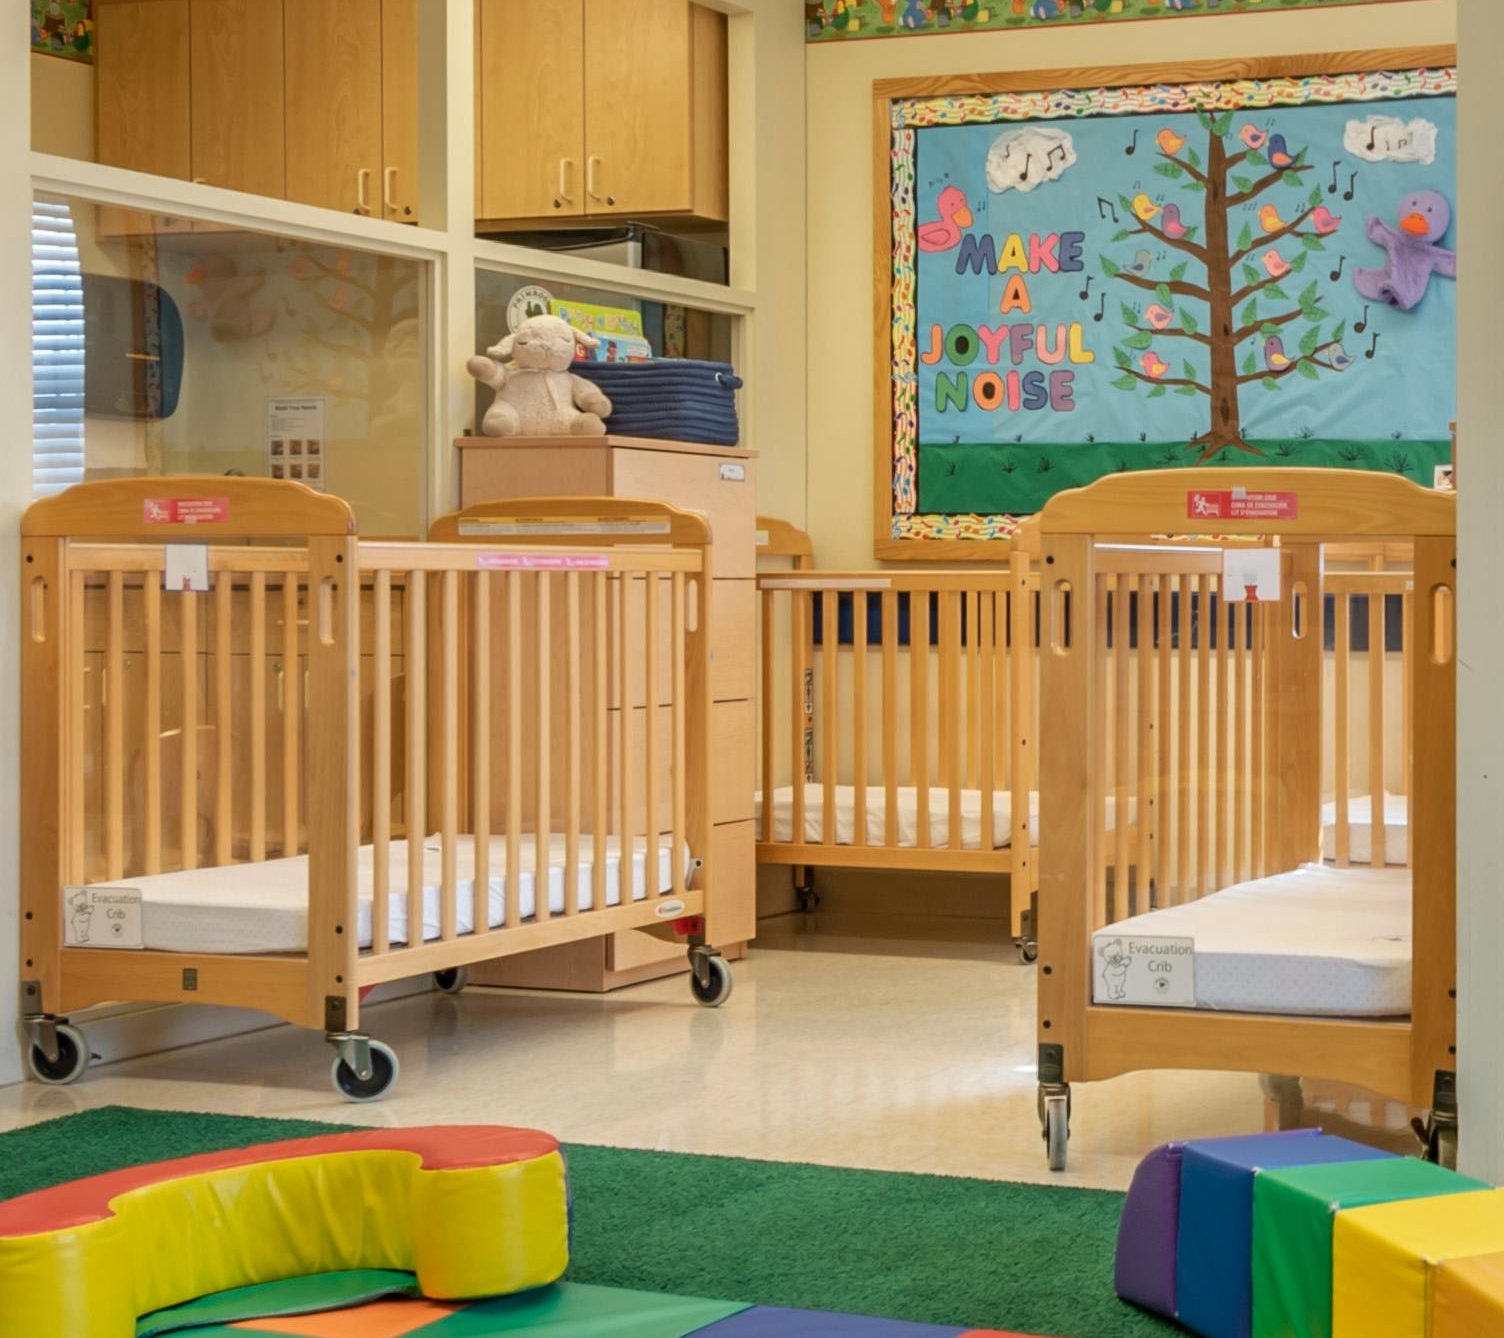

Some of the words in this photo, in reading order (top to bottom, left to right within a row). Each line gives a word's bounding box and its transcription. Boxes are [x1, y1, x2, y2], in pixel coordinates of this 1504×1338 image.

[955, 231, 1085, 275] MAKE
[1000, 274, 1032, 314] A
[920, 322, 1095, 366] JOYFUL
[935, 370, 1076, 413] NOISE
[92, 892, 142, 905] Evacuation
[107, 909, 126, 919] Crib
[1128, 942, 1193, 956] Evacuation
[1148, 960, 1173, 973] Crib
